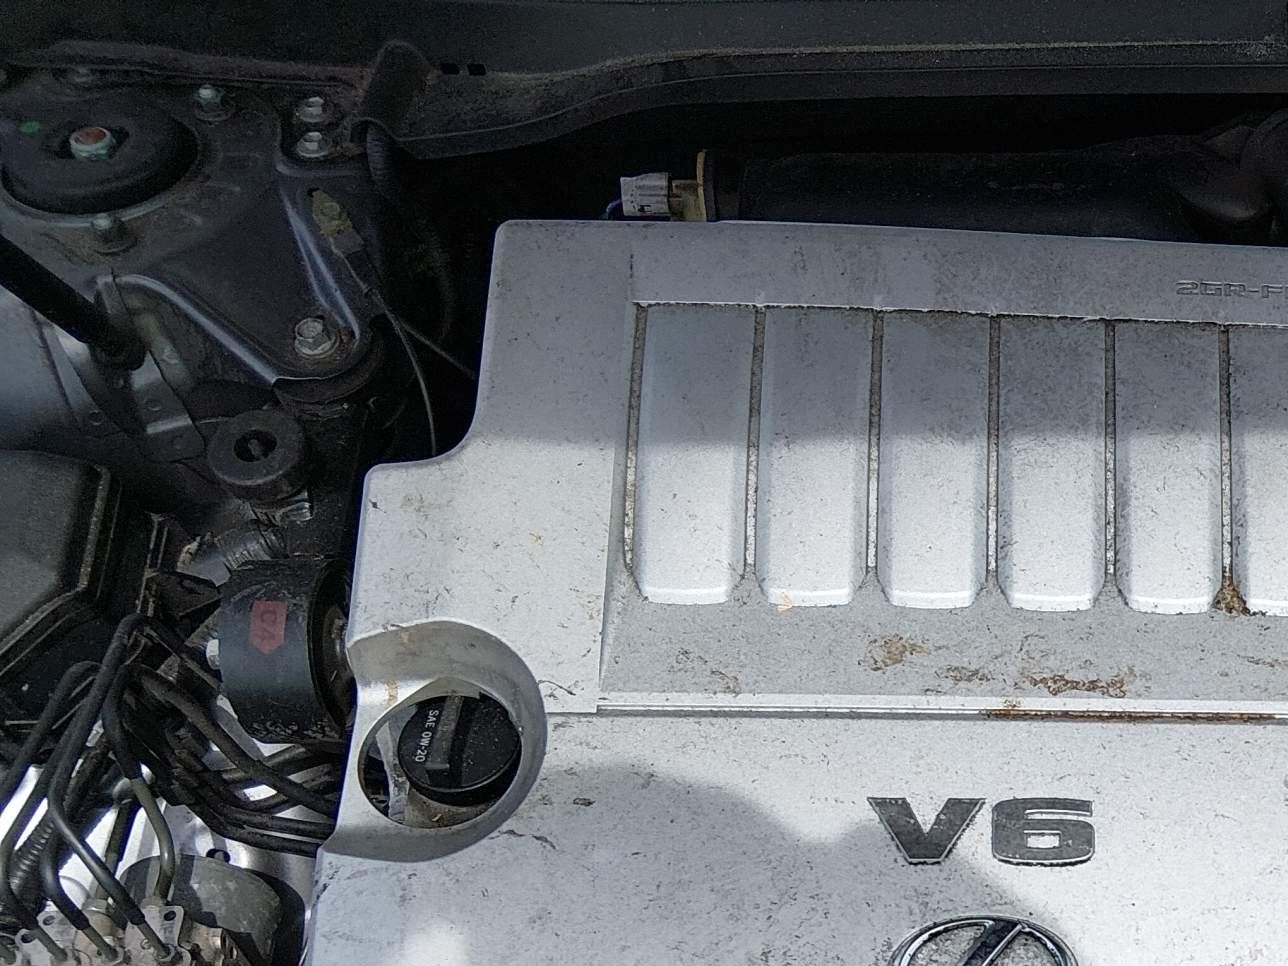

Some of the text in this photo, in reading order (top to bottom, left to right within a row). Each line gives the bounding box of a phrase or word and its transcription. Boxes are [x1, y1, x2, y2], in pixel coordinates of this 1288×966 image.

[414, 710, 439, 762] SAE 0W-20
[867, 797, 1096, 867] V6
